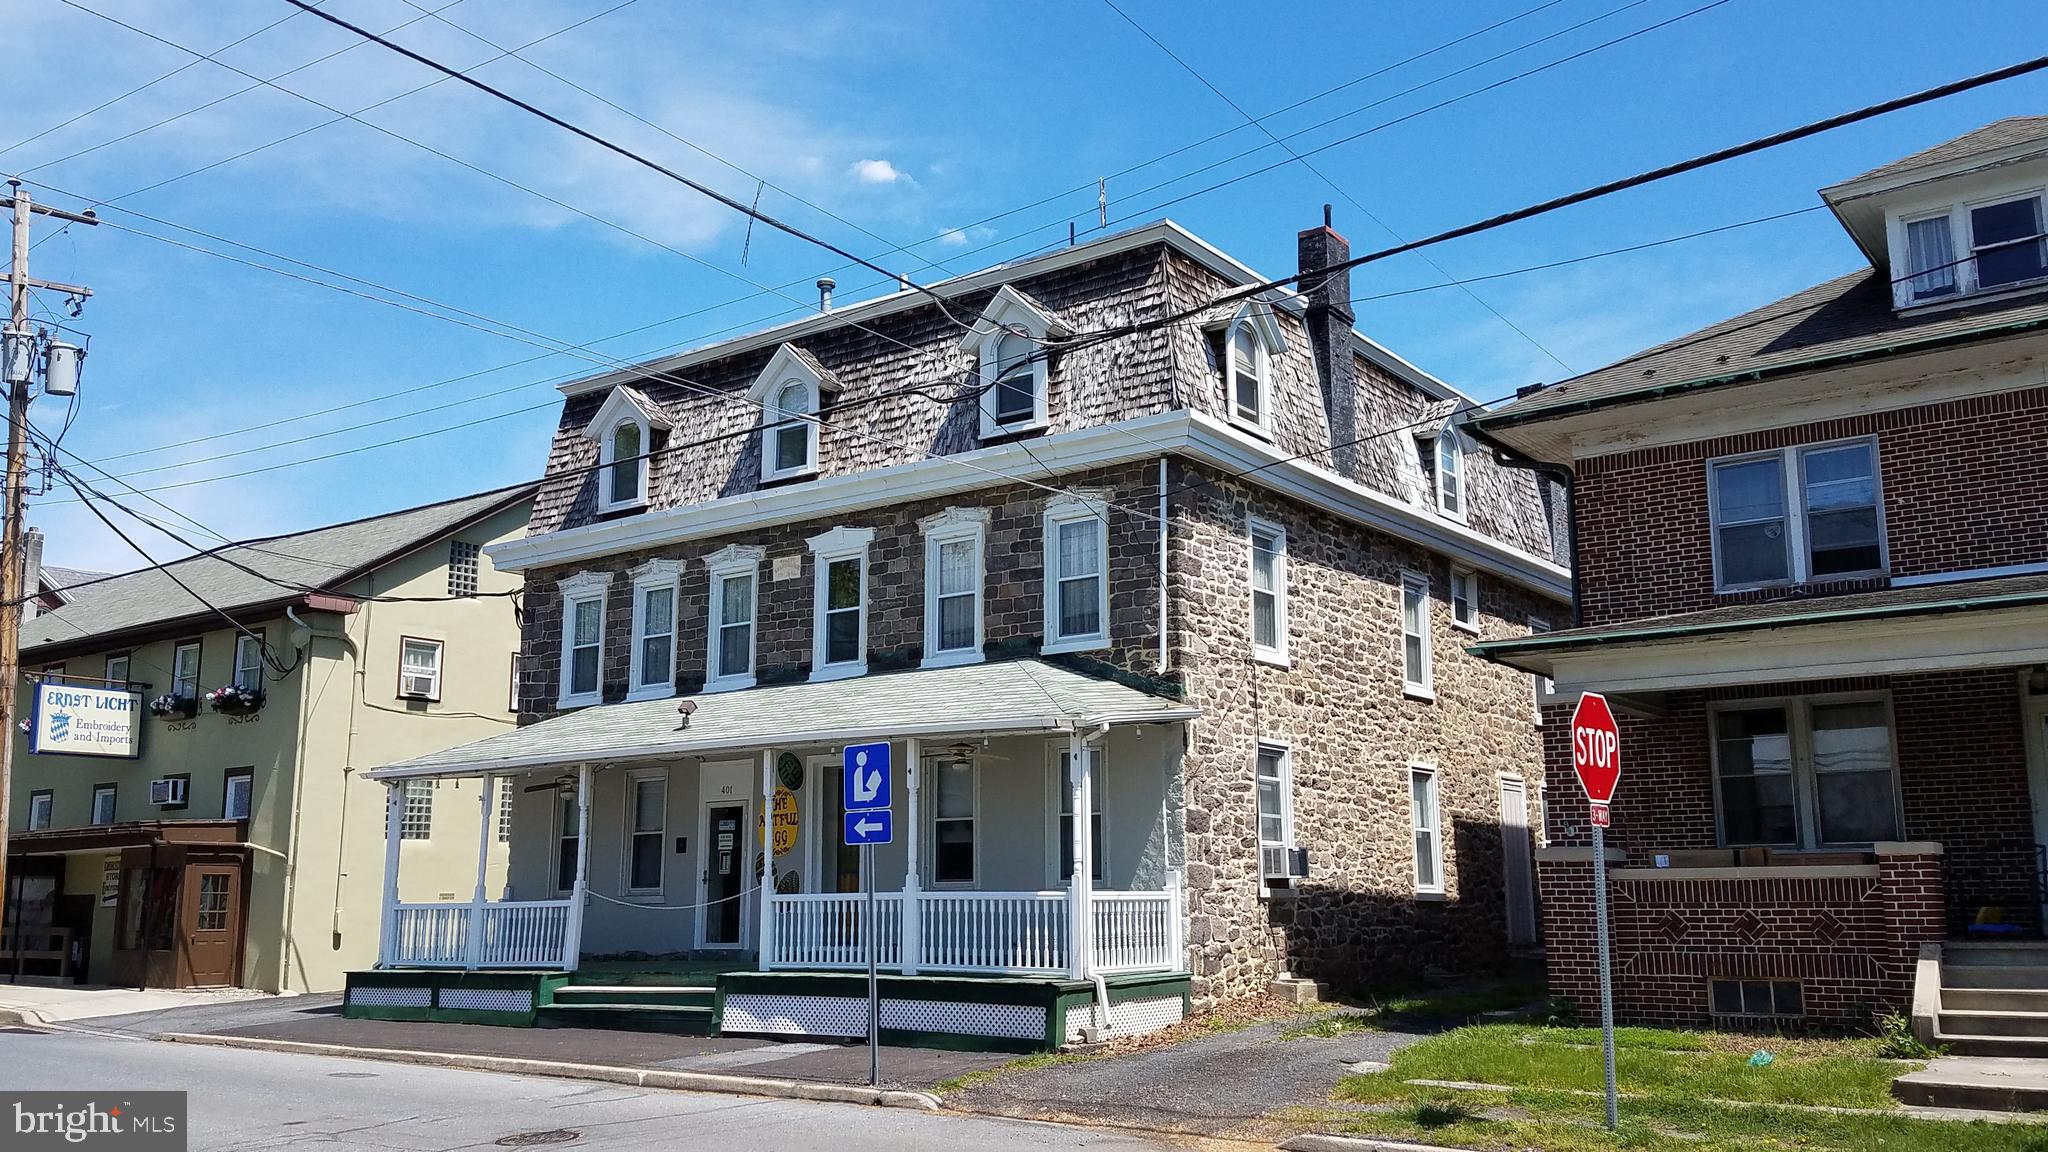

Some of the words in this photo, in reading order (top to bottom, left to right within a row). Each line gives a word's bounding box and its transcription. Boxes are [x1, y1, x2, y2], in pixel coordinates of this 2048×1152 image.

[47, 691, 92, 708] ERNST
[95, 696, 139, 711] LICHT
[76, 718, 132, 735] Embroidery
[73, 731, 92, 742] and
[96, 732, 134, 746] Imports
[1576, 726, 1616, 768] STOP
[720, 784, 734, 794] 401
[759, 812, 799, 827] ATFUL
[1592, 808, 1608, 823] 3-WAY
